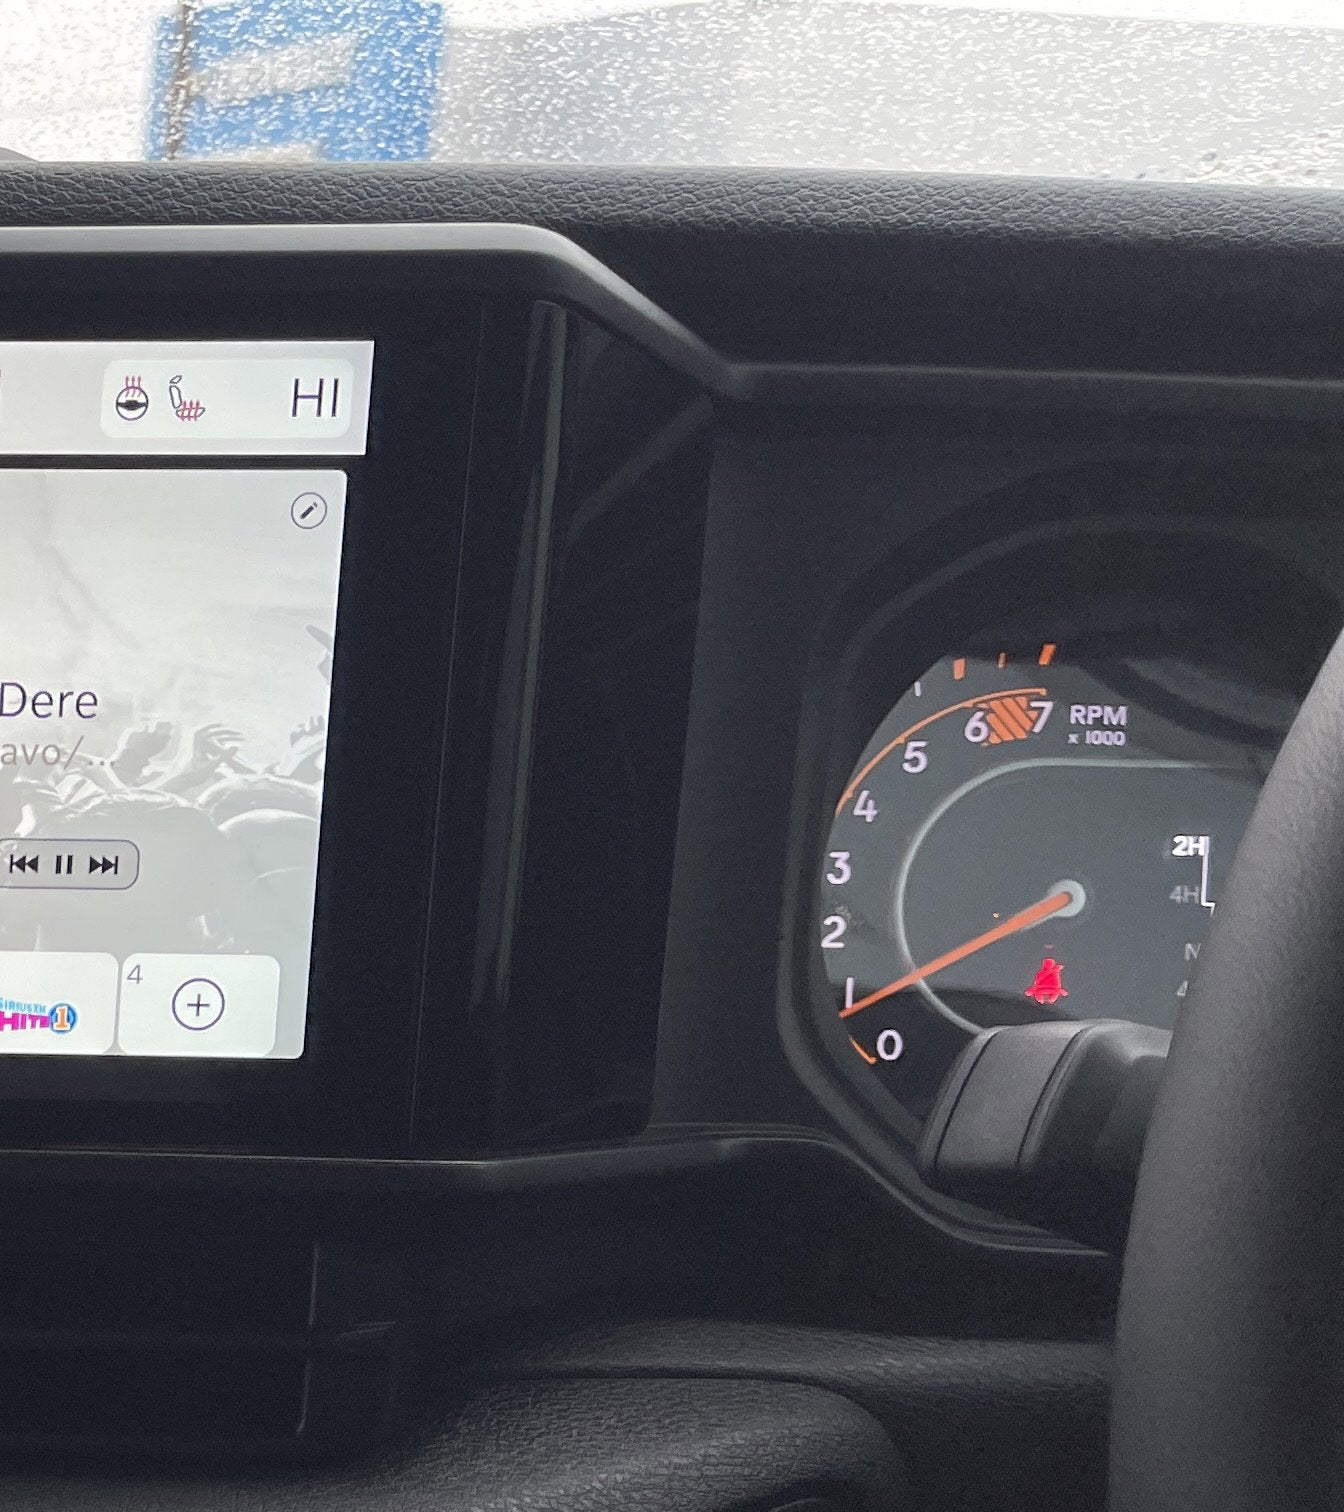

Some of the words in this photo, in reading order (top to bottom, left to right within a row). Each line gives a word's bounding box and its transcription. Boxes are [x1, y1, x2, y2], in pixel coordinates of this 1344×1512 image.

[292, 378, 340, 420] HI
[0, 682, 98, 719] Dere
[1070, 704, 1128, 726] RPM
[965, 710, 989, 743] 6
[1030, 701, 1053, 733] 7
[1085, 731, 1127, 746] 1000
[902, 740, 928, 774] 5
[853, 790, 878, 822] 4
[1172, 835, 1208, 857] 2H
[826, 851, 851, 884] 3
[1169, 885, 1200, 904] 4H
[821, 915, 847, 948] 2
[126, 964, 143, 985] 4
[876, 1028, 903, 1061] 0
